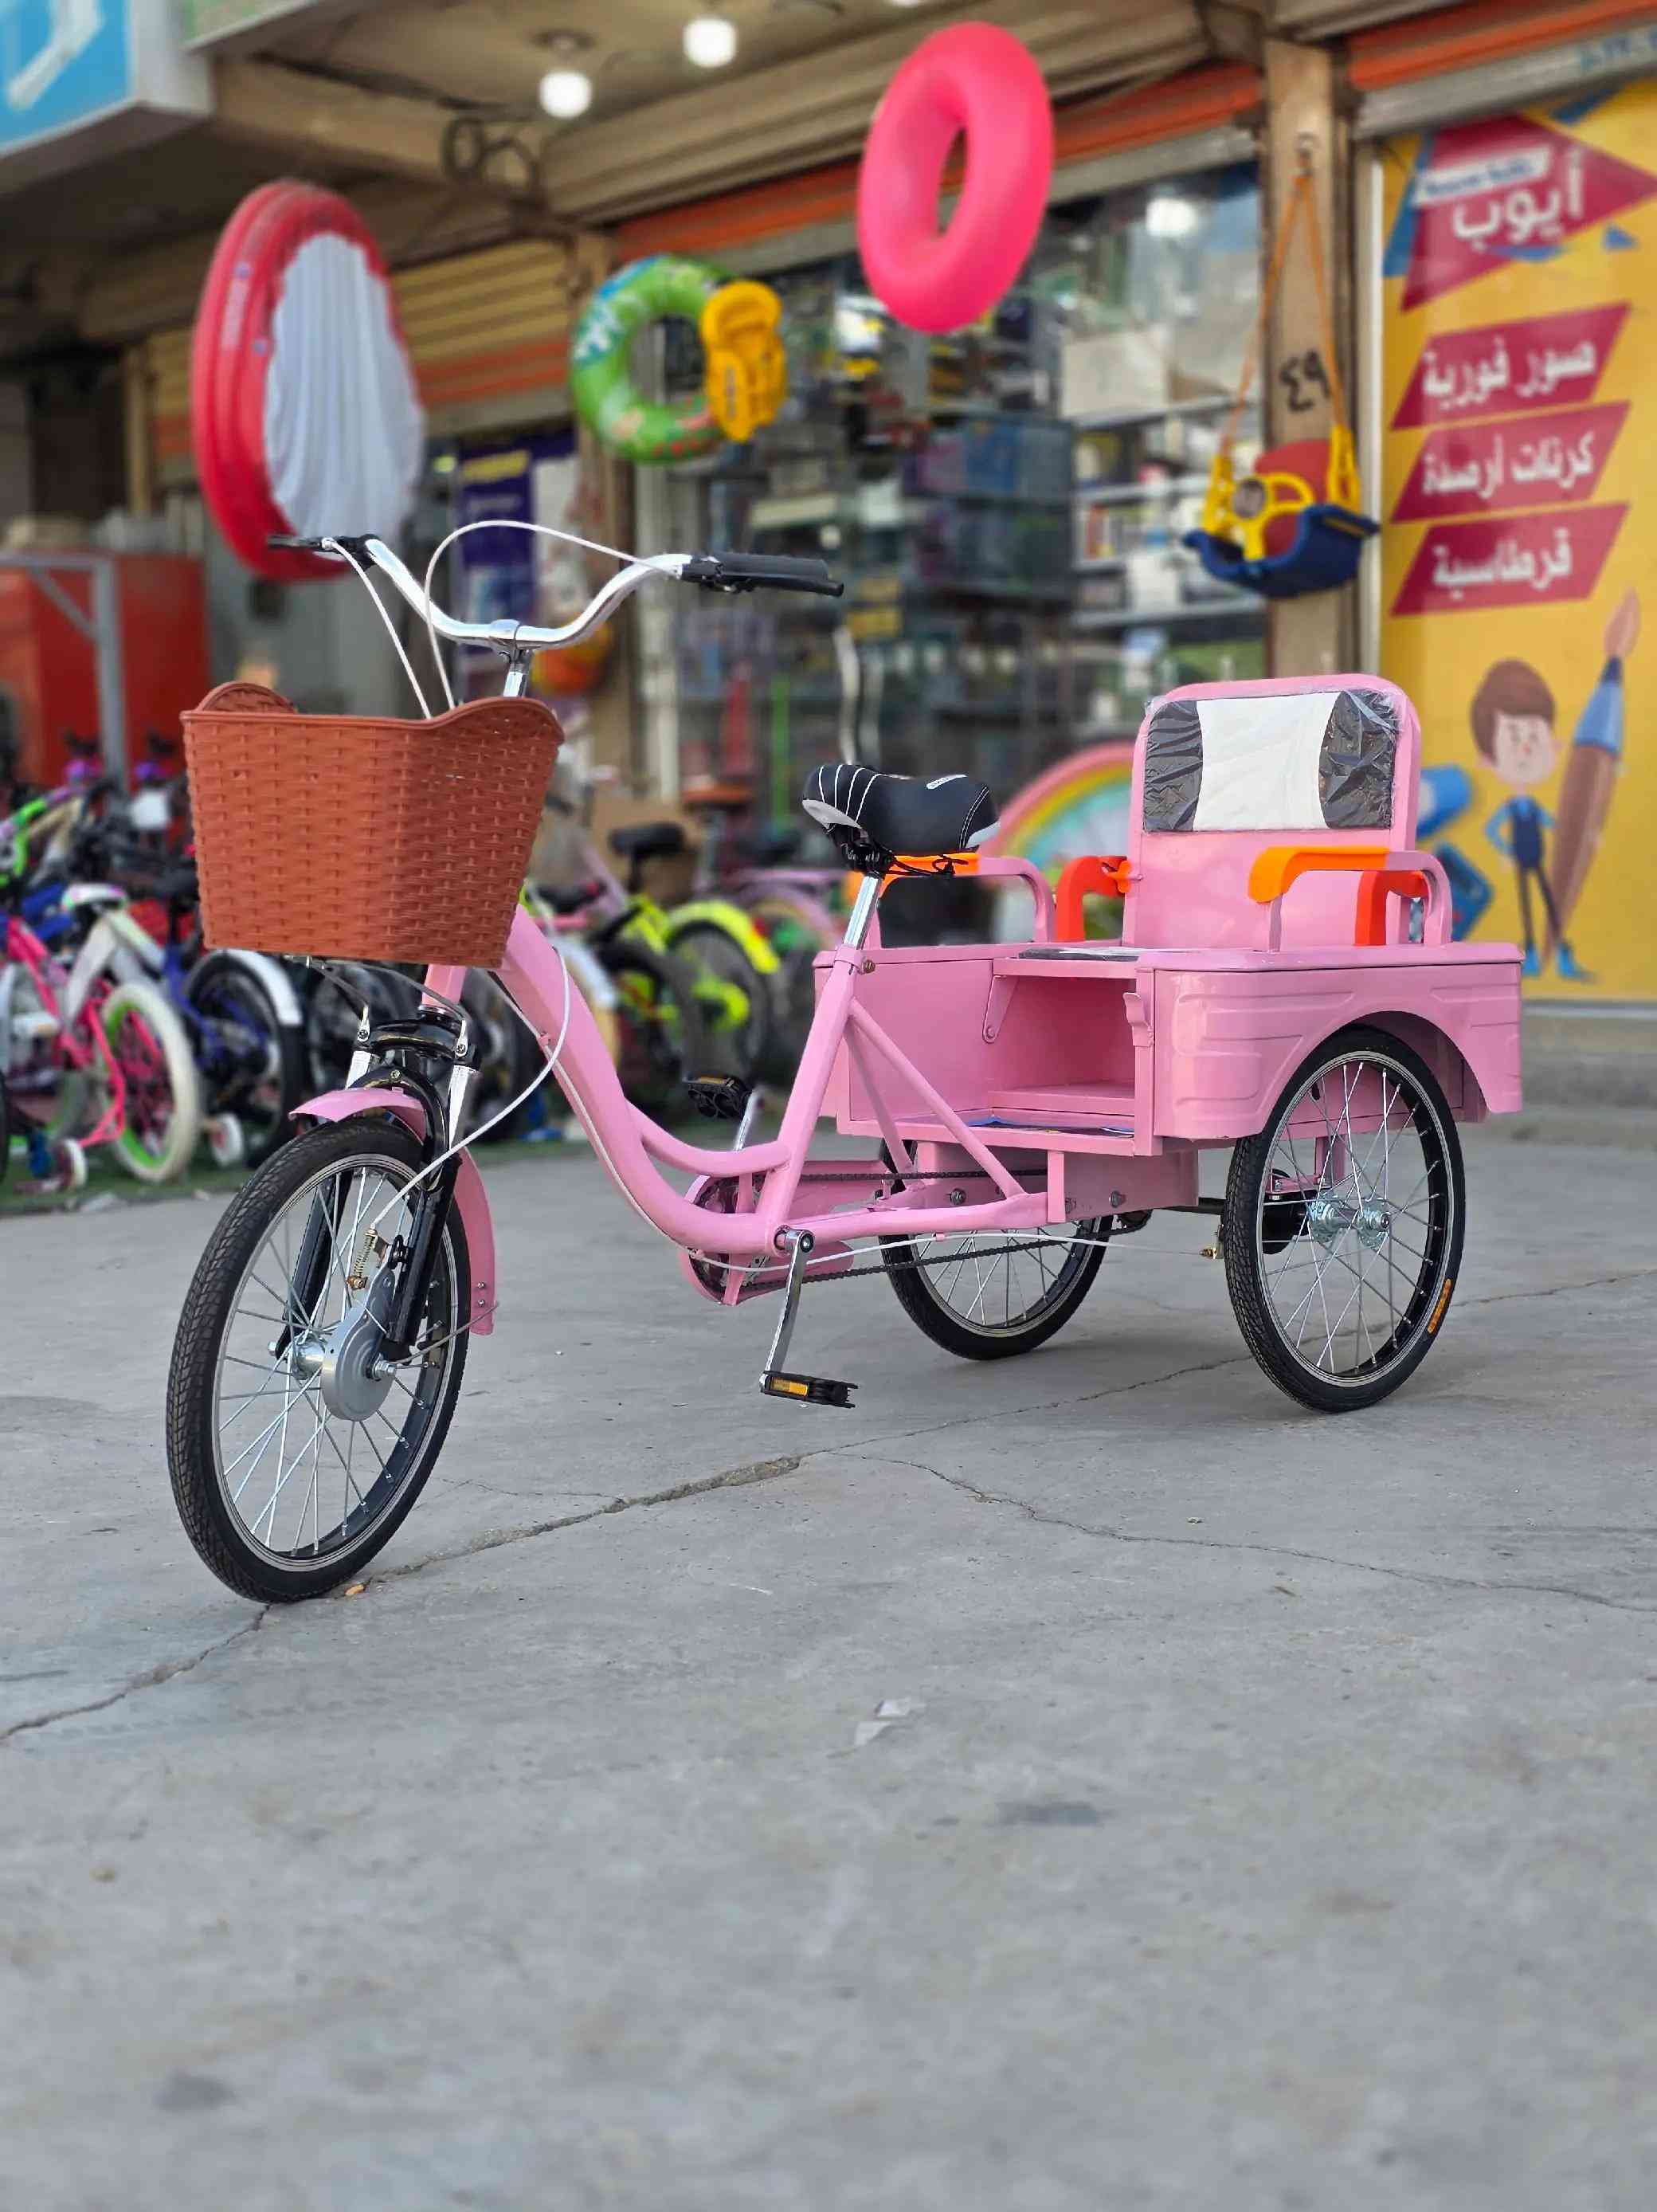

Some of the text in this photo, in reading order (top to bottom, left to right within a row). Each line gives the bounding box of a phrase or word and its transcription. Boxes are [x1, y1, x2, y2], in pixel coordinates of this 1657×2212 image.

[1421, 335, 1596, 411] صور فورية
[1432, 526, 1572, 601] قرطاسية
